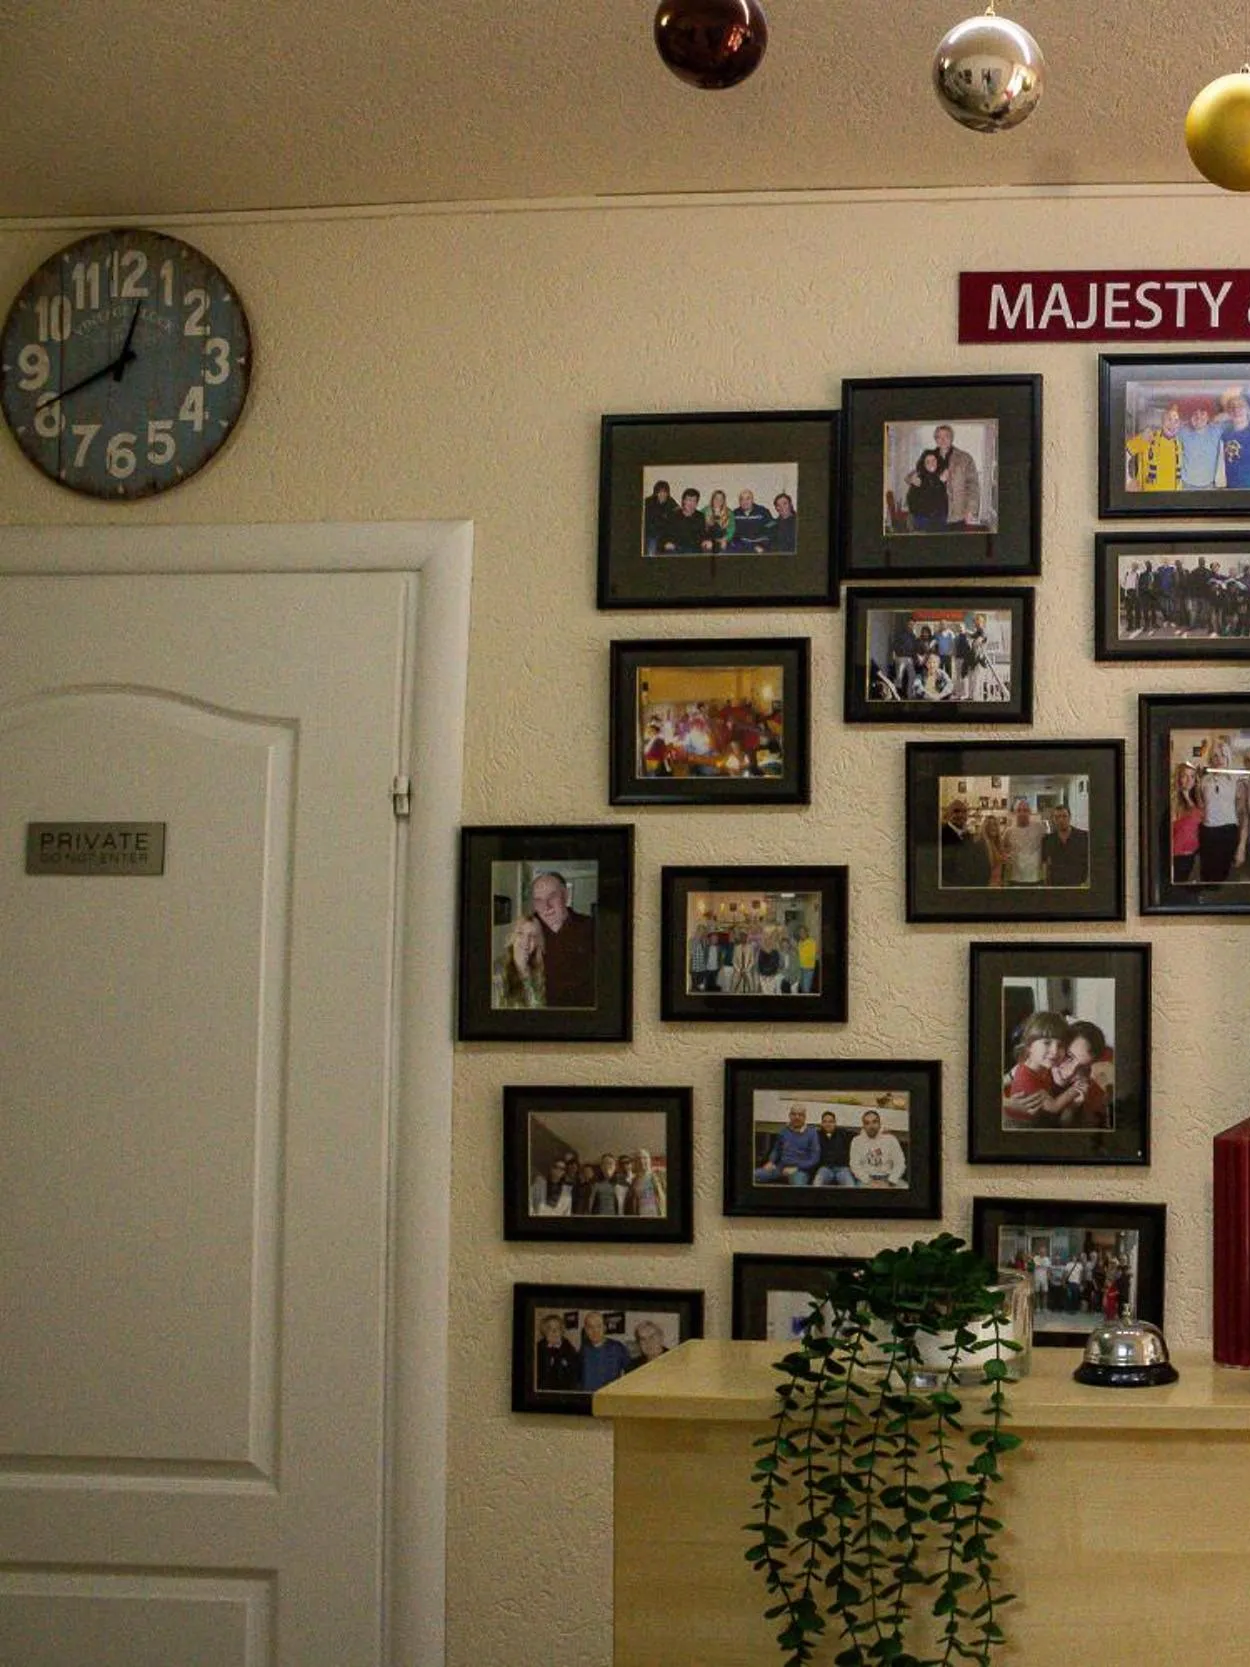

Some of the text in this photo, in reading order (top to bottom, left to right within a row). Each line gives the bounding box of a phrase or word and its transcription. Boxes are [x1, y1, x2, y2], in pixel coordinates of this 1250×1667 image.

[72, 262, 100, 309] 11
[106, 249, 148, 298] 12
[160, 260, 173, 307] 1
[35, 295, 71, 342] 10
[184, 289, 210, 336] 2
[988, 281, 1232, 330] MAJESTY
[18, 344, 49, 391] 9
[204, 338, 230, 385] 3
[34, 392, 66, 437] 8
[179, 386, 209, 432] 4
[72, 424, 102, 467] 7
[106, 432, 137, 478] 6
[147, 420, 176, 465] 5
[40, 832, 148, 851] PRIVATE
